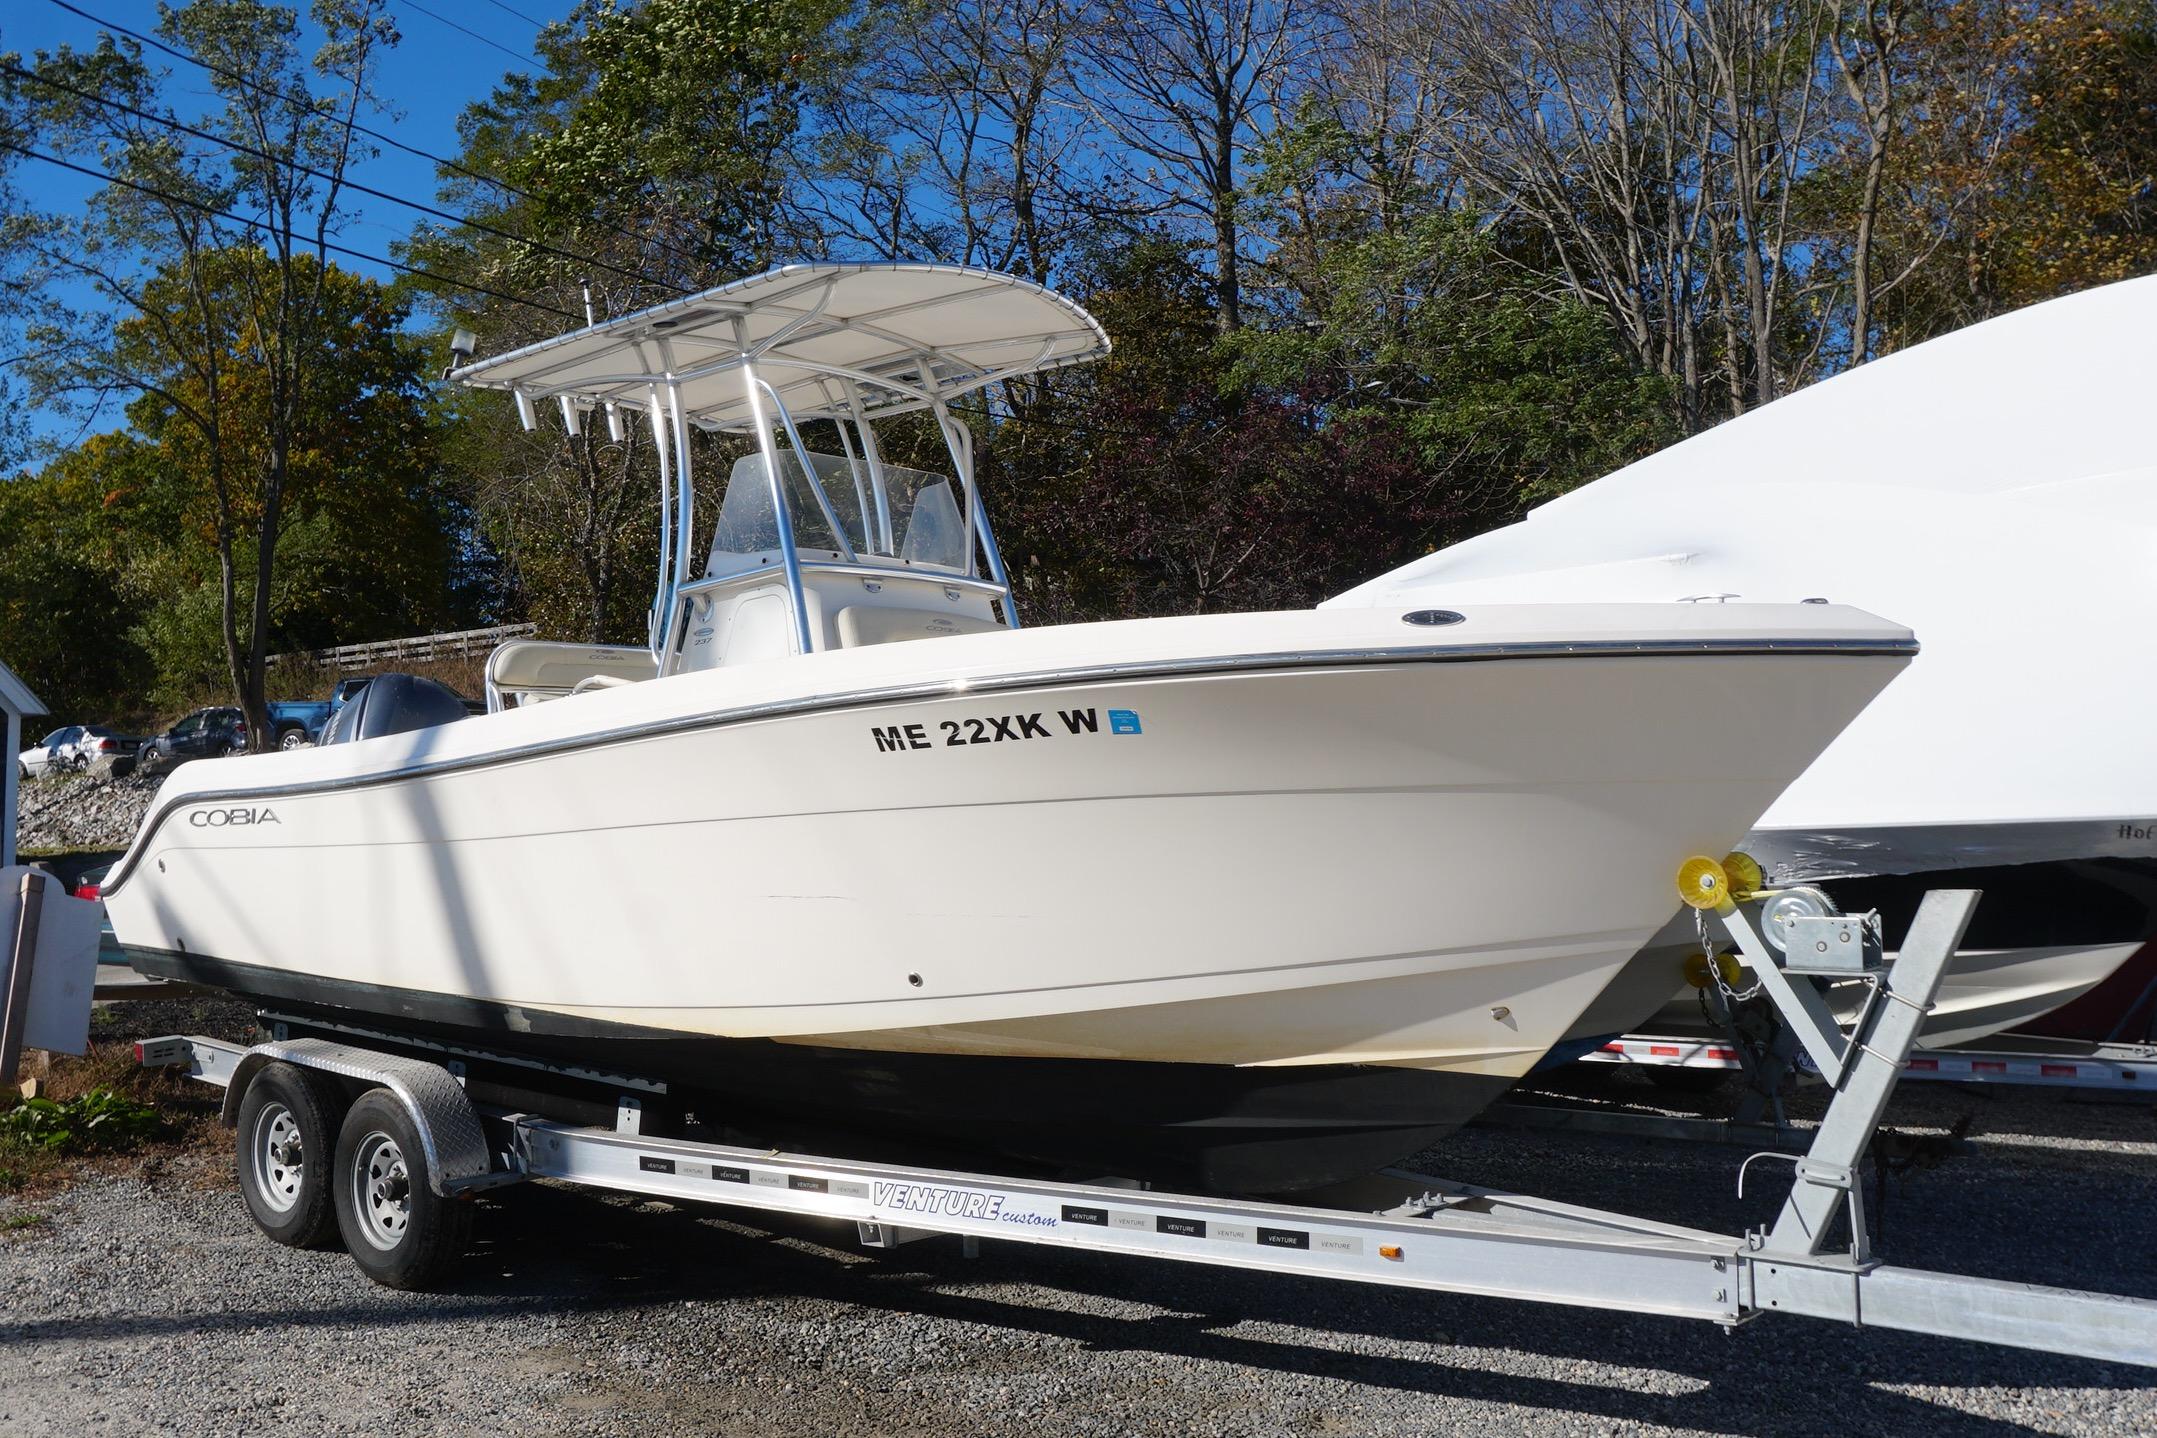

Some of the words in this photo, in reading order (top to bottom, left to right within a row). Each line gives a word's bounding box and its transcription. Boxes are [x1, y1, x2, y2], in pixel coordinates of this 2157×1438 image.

[871, 724, 932, 752] ME
[939, 712, 1052, 746] 22XK
[1057, 708, 1099, 735] W
[189, 807, 282, 828] COBIA
[720, 1171, 741, 1179] VENTURE
[874, 1182, 1006, 1221] VENTURE
[1001, 1211, 1058, 1228] custom
[1071, 1212, 1098, 1222] VENTURE
[1167, 1223, 1195, 1233] VENTURE
[1217, 1229, 1245, 1238] VENTURE
[1268, 1235, 1298, 1245] VENTURE
[1320, 1240, 1352, 1250] VENTURE
